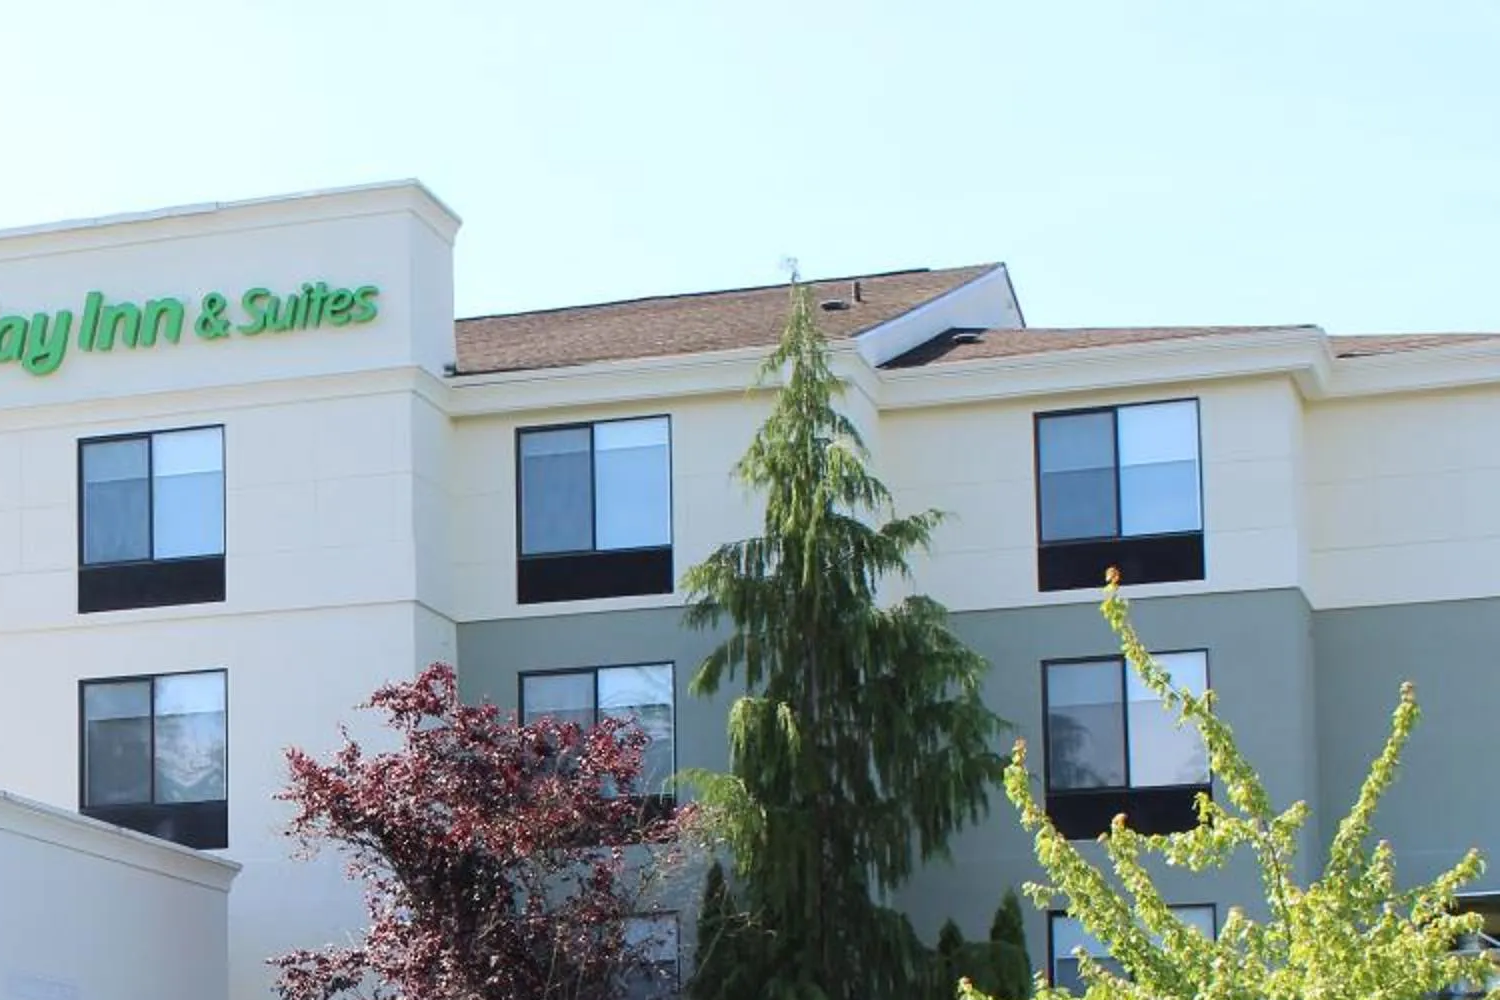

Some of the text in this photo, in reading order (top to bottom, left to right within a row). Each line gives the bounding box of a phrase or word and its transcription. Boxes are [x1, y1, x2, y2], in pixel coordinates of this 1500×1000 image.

[78, 291, 185, 352] Inn
[195, 292, 231, 340] &
[237, 281, 380, 336] Suites
